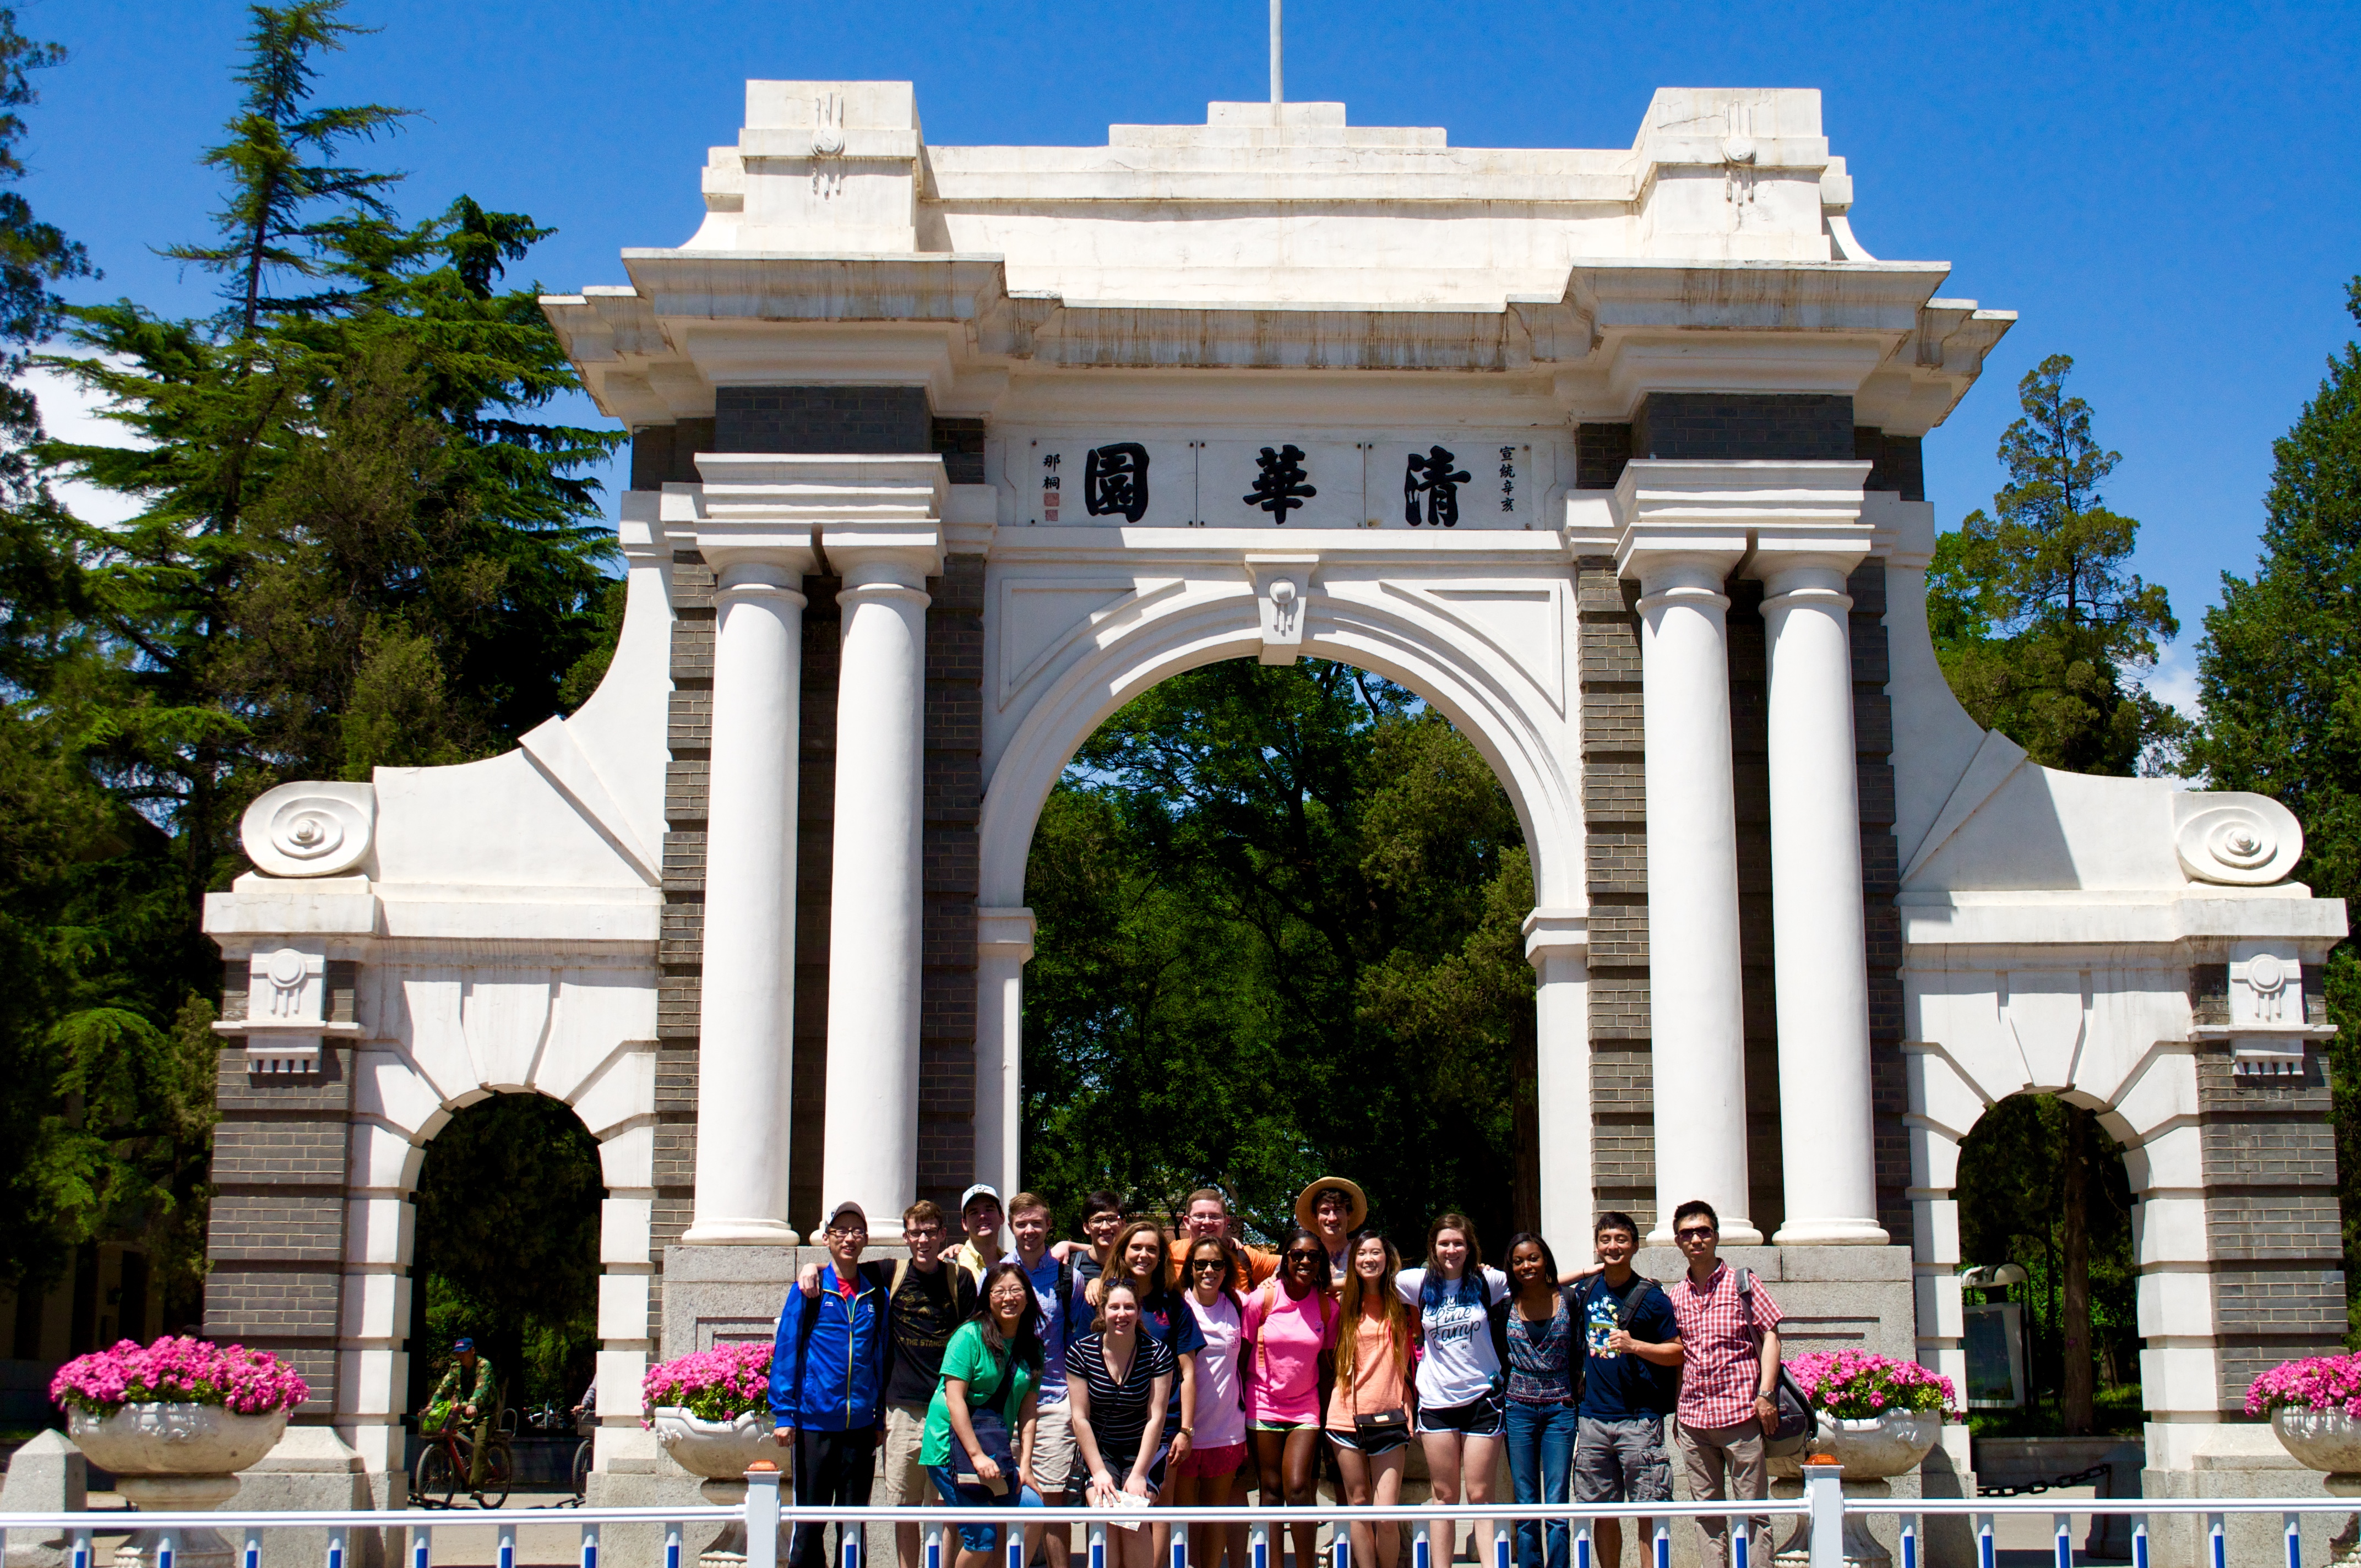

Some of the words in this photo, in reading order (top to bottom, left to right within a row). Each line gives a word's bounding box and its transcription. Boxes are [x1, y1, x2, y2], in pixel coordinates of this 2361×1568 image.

[1042, 453, 1061, 490] 那桐
[1499, 445, 1516, 512] 宣統辛亥
[1429, 1308, 1472, 1335] Line
[1432, 1320, 1481, 1350] Camp
[906, 1338, 918, 1346] THE
